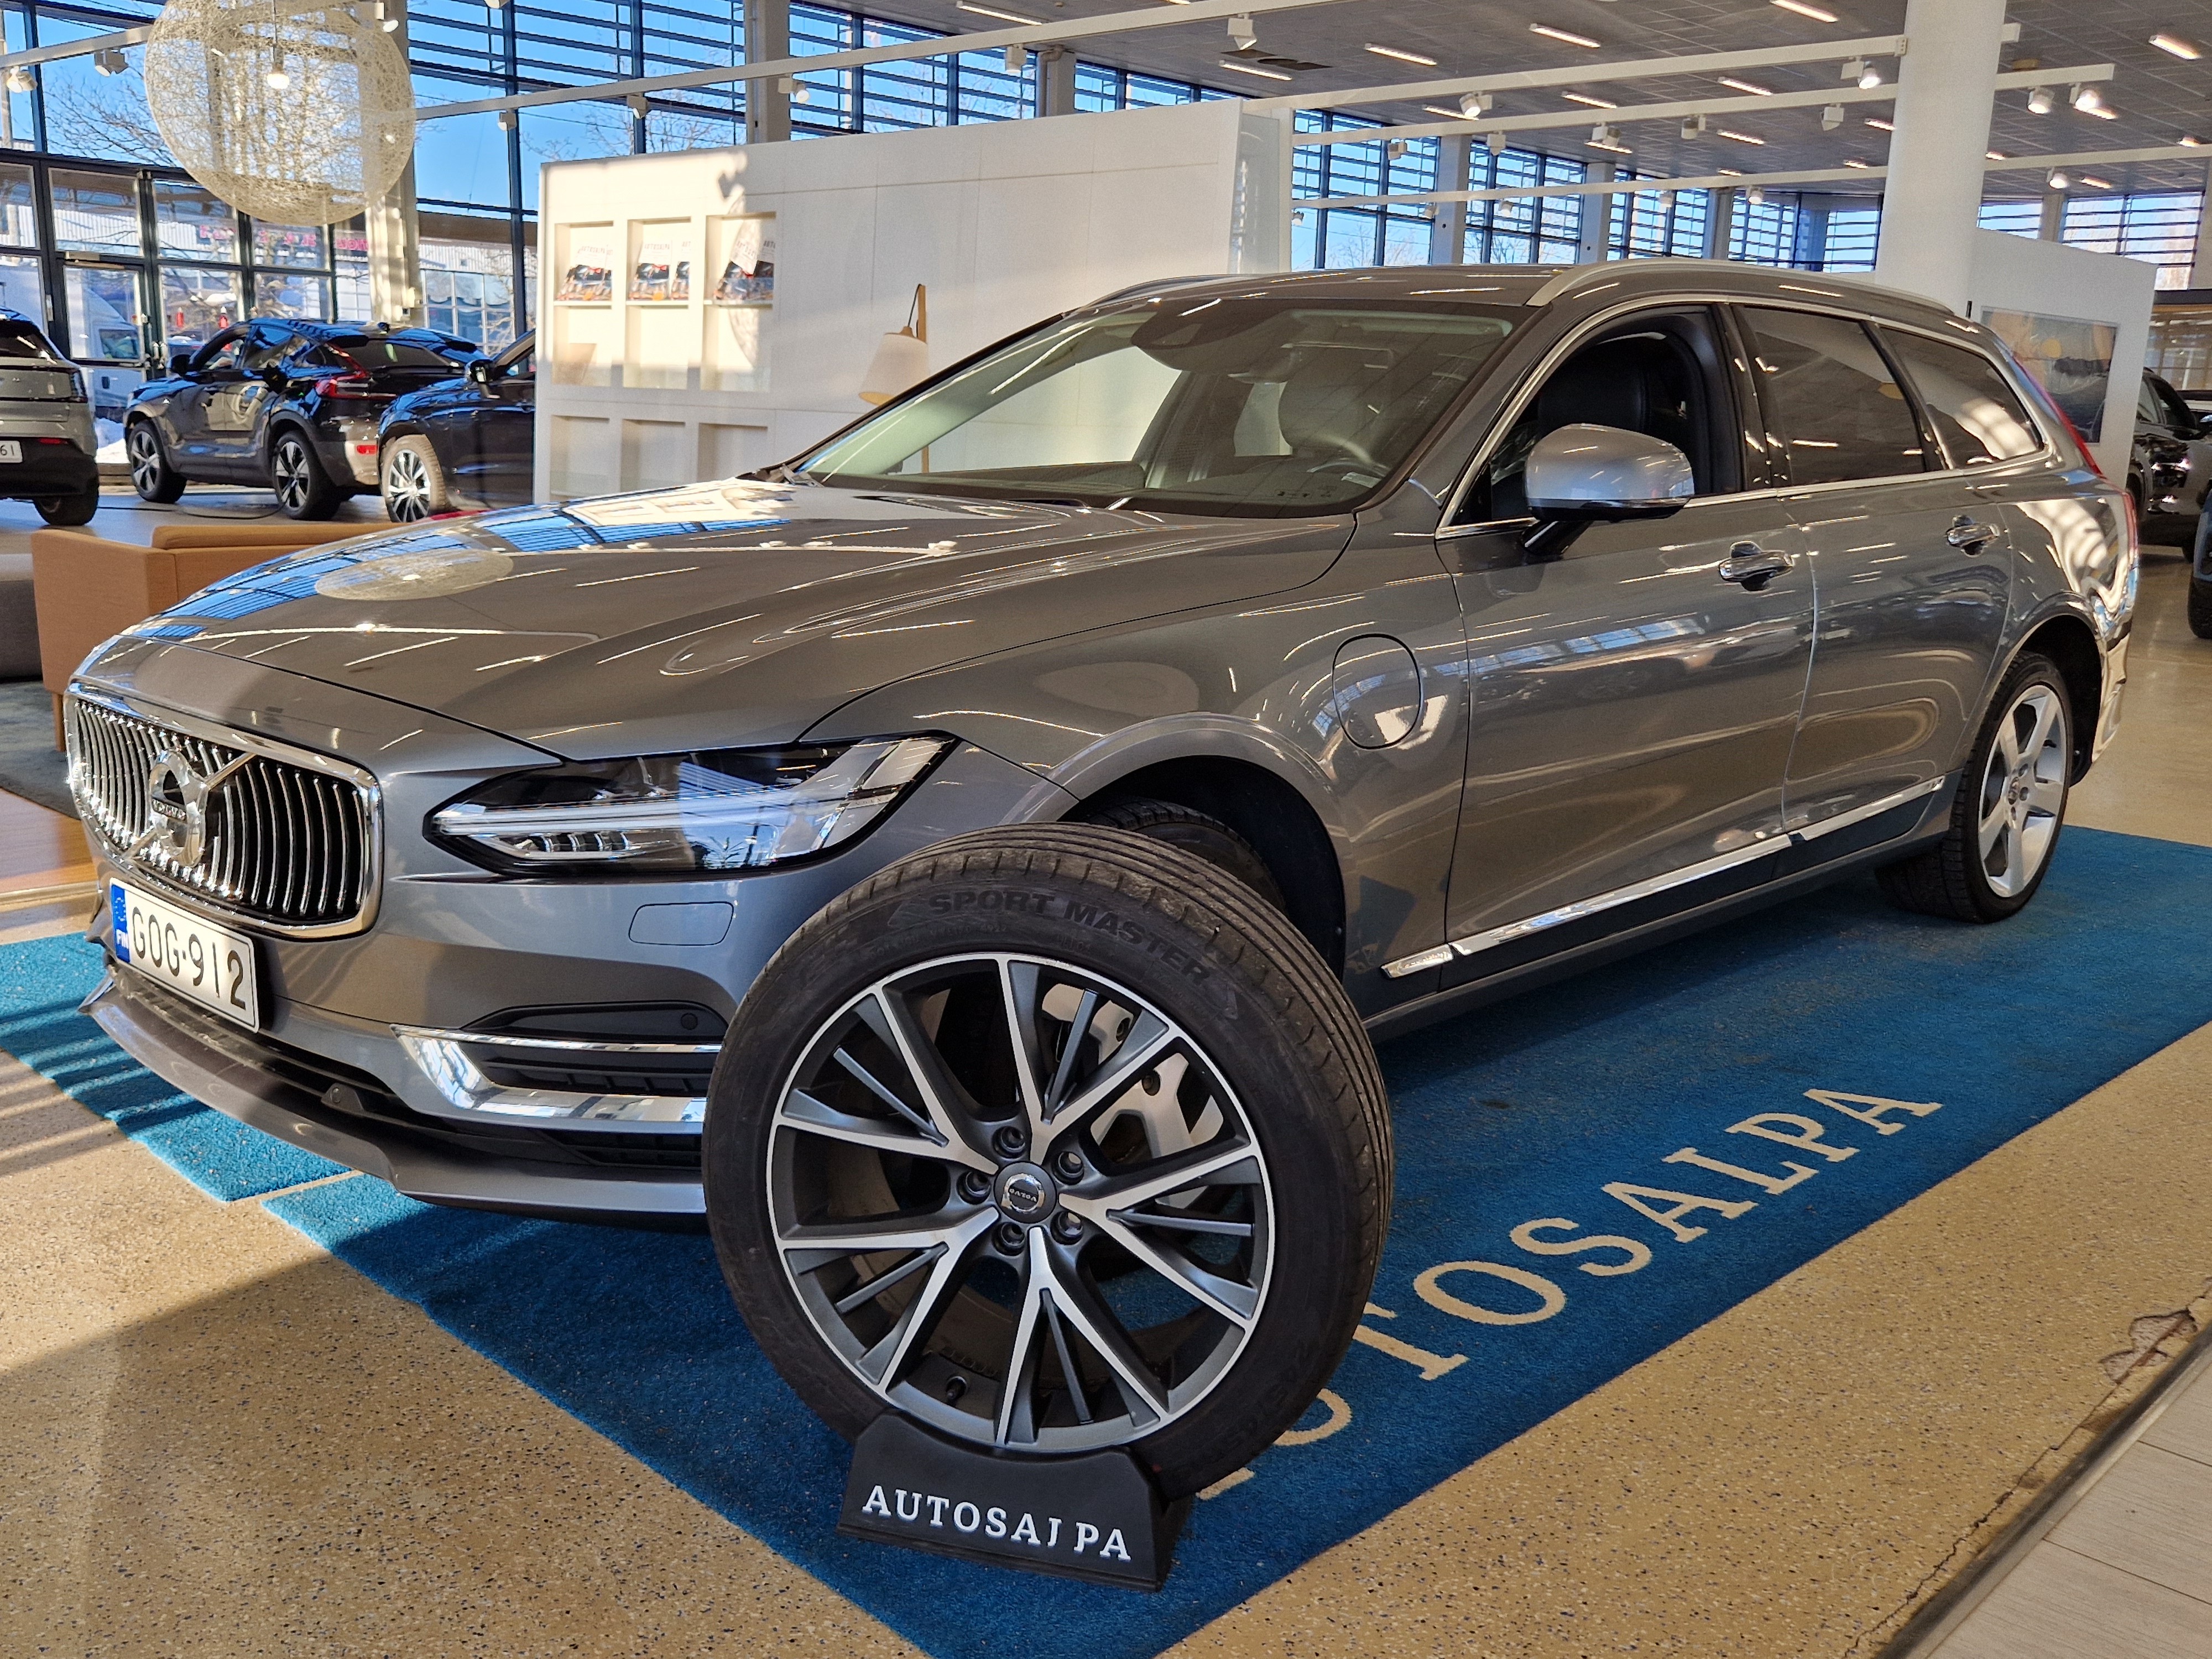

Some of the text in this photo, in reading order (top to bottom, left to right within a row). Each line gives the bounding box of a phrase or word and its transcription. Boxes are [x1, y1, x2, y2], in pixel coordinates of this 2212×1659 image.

[116, 928, 129, 949] FIN
[132, 906, 246, 1011] GOG-912
[928, 889, 1211, 985] SPORT MASTER
[1196, 1088, 1942, 1500] TOSALPA
